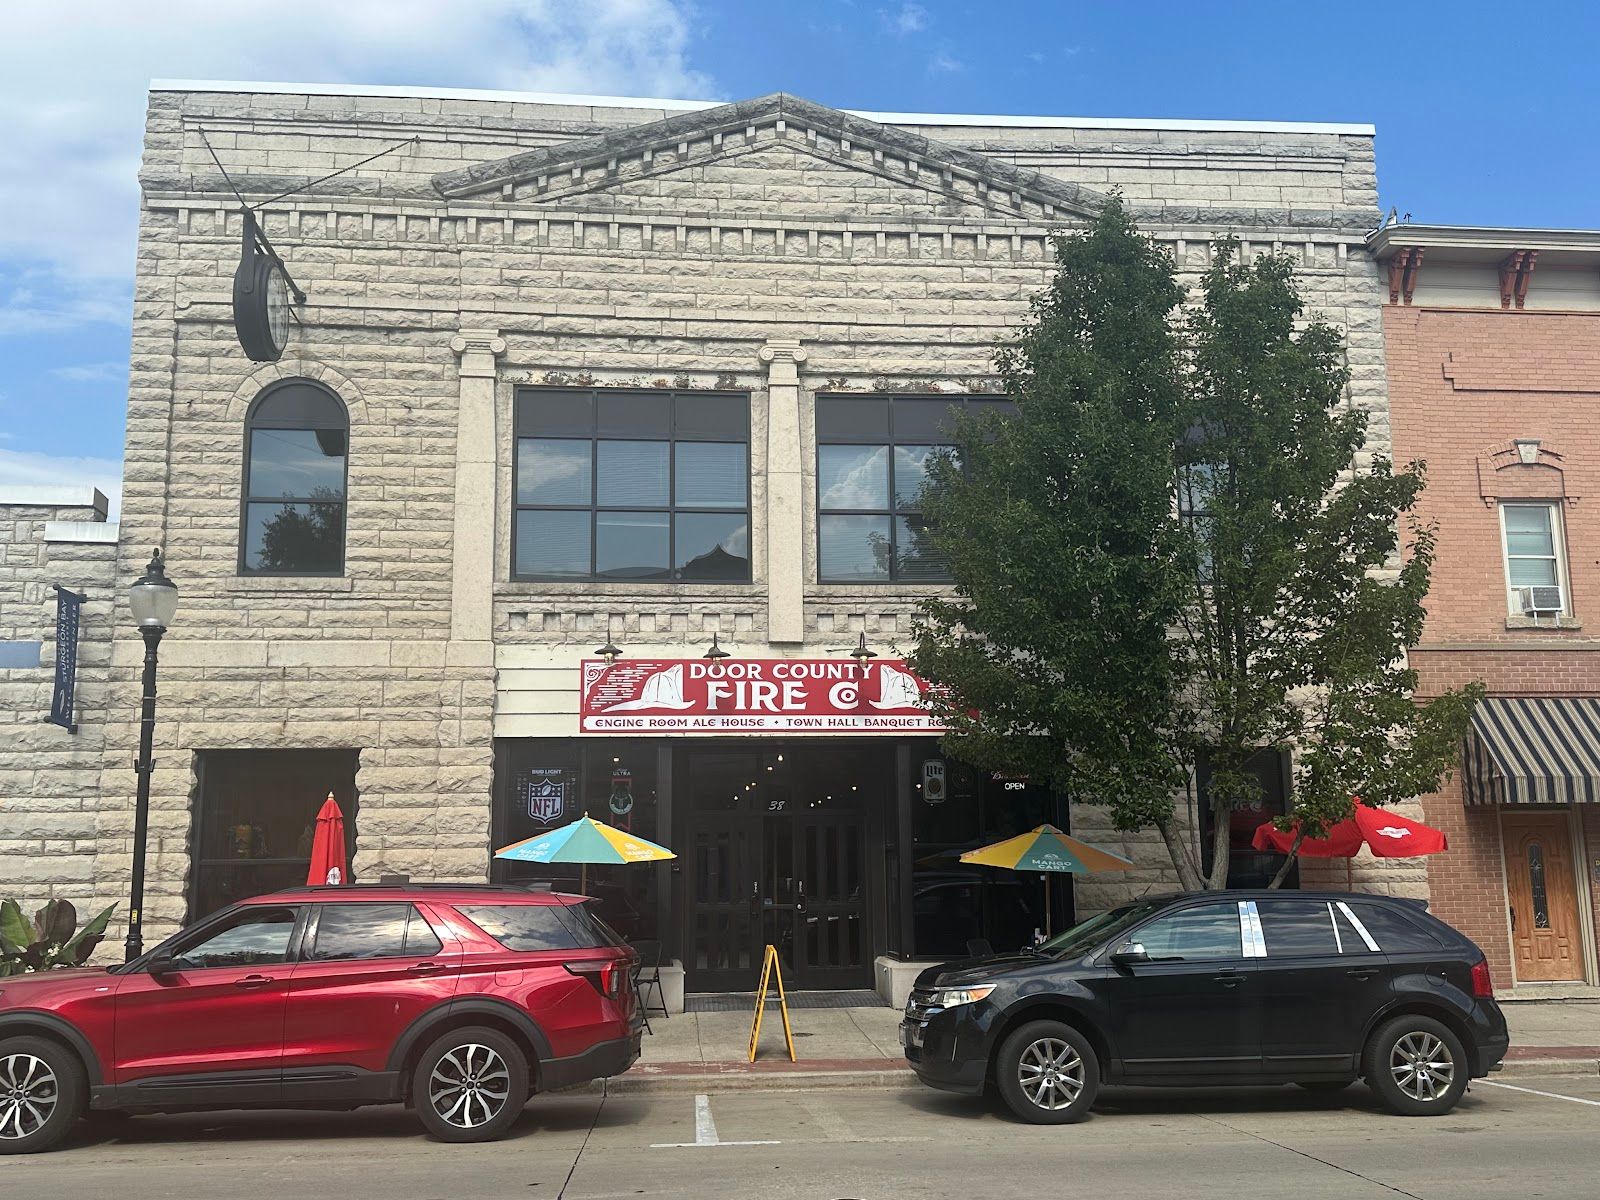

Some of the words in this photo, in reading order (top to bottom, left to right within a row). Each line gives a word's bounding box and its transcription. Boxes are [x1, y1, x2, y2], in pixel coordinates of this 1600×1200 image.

[690, 663, 763, 680] DOOR
[772, 663, 874, 679] COUNTY
[706, 680, 809, 712] FIRE
[595, 719, 643, 727] ENGINE
[649, 719, 687, 727] ROOM
[693, 718, 716, 726] ALE
[721, 718, 765, 726] HOUSE
[786, 718, 822, 726] TOWN
[828, 718, 858, 726] HALL
[864, 718, 922, 727] BANQUET
[926, 765, 943, 778] Lite
[1004, 782, 1025, 790] OPEN
[532, 798, 559, 818] NFL
[768, 800, 786, 810] 38
